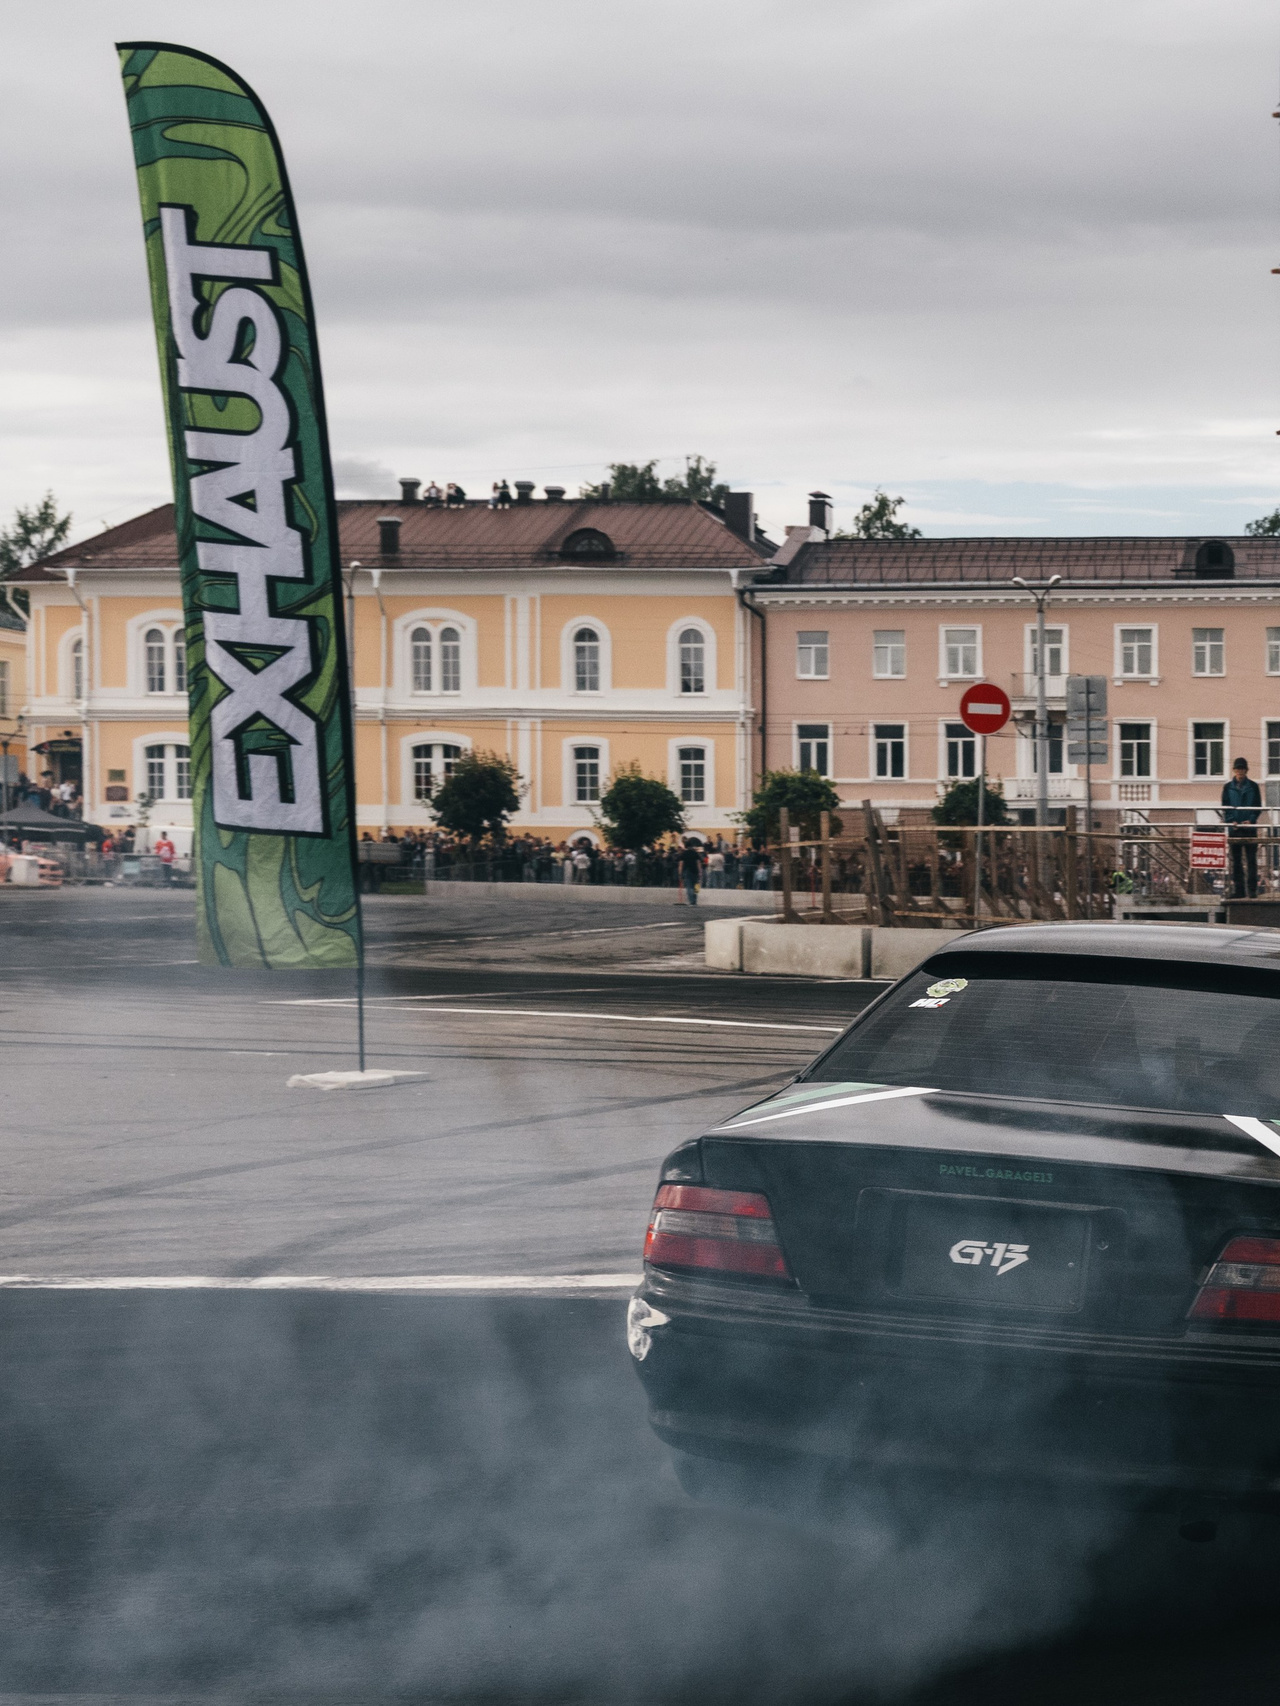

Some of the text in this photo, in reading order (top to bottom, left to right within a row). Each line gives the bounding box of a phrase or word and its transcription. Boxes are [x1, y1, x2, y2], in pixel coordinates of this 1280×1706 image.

[160, 206, 324, 833] EXHAUST
[1192, 857, 1223, 866] ЗАКРЫТ
[940, 1164, 1053, 1183] PAVEL_GARAGE13
